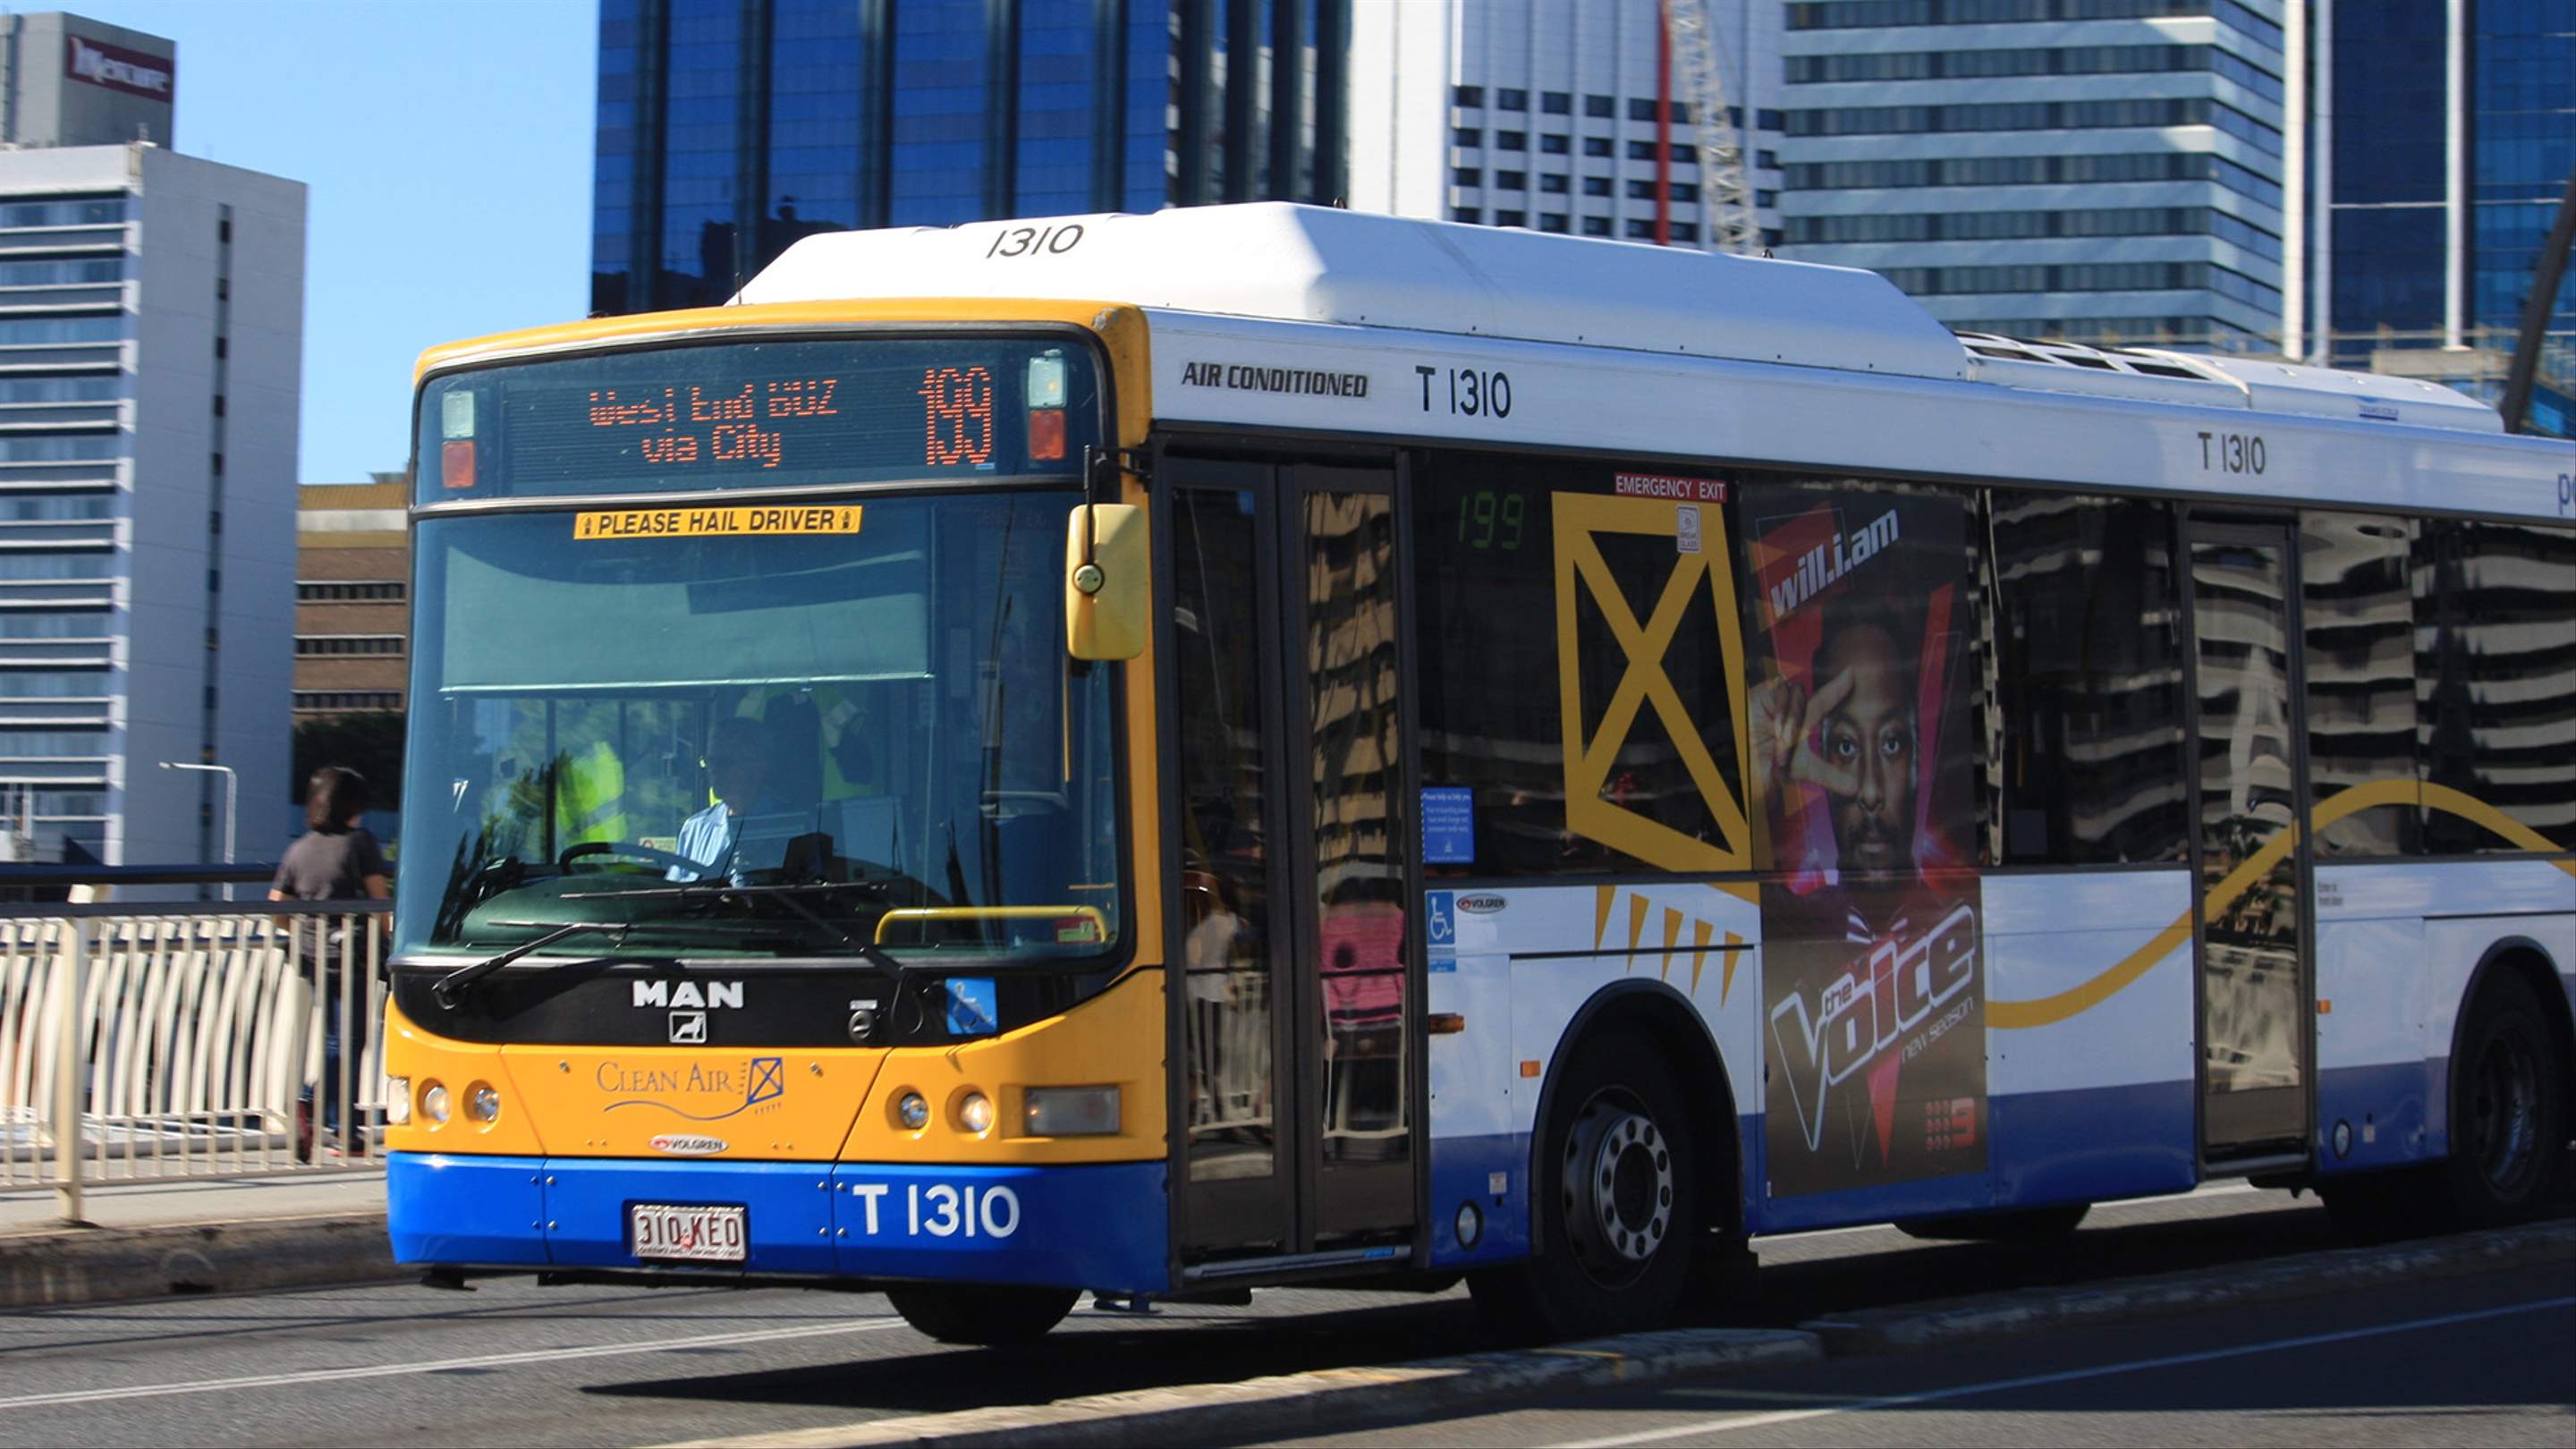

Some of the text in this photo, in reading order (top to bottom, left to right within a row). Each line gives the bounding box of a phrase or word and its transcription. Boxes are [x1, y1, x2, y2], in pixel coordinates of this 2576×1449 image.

[987, 225, 1084, 258] 1310
[1182, 362, 1368, 397] AIR CONDITIONED
[1415, 366, 1512, 419] T 1310
[917, 366, 991, 465] 199
[641, 424, 781, 468] via City
[2198, 432, 2266, 475] T 1310
[1615, 476, 1725, 500] EMERGENCY EXIT
[598, 510, 835, 535] PLEASE HAIL DRIVER
[1460, 492, 1524, 550] 199
[1771, 509, 1900, 618] will.i.am
[1471, 898, 1504, 909] VOLGREN
[632, 980, 744, 1009] MAN
[1825, 983, 1853, 1014] the
[1929, 996, 1973, 1042] season
[671, 1139, 723, 1151] VOLGREN
[852, 1184, 1020, 1239] T 1310
[639, 1216, 680, 1246] 310
